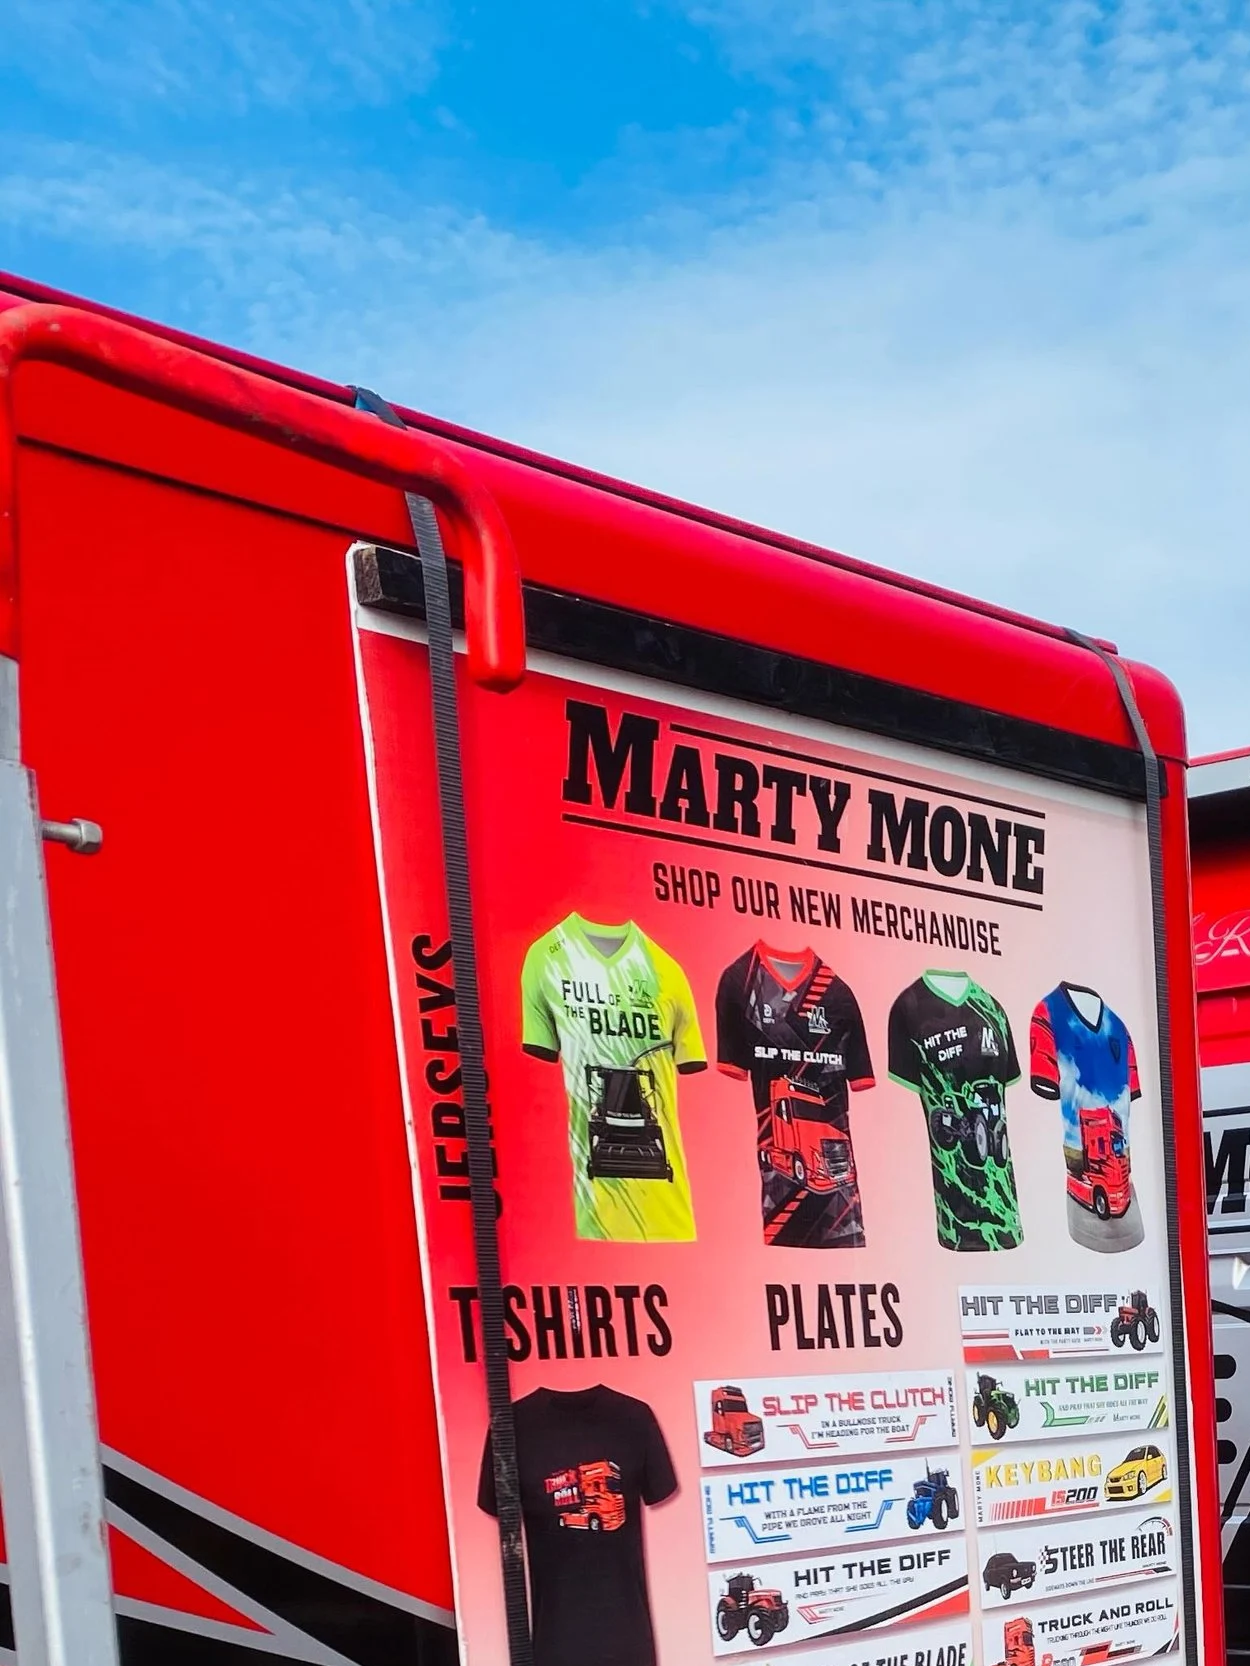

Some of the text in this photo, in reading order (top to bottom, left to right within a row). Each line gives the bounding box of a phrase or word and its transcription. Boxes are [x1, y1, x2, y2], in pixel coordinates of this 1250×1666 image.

[561, 699, 1045, 894] MARTY MONE
[653, 861, 1002, 956] SHOP OUR NEW MERCHANDISE
[562, 980, 620, 1005] FULL OF
[564, 1005, 661, 1040] THE BLADE
[923, 1026, 967, 1049] HIT THE
[754, 1046, 842, 1065] SLIP THE CLUTCH
[938, 1045, 963, 1061] DIFF
[411, 934, 503, 1219] JERSEYS
[766, 1283, 903, 1351] PLATES
[961, 1294, 1118, 1316] HIT THE DIFF
[1036, 1328, 1046, 1336] TO
[1024, 1371, 1159, 1397] HIT THE DIFF
[763, 1387, 946, 1416] SLIP THE CLUTCH
[821, 1420, 830, 1428] IN
[838, 1417, 876, 1427] BULLNOSE
[877, 1416, 901, 1424] TRUCK
[826, 1429, 859, 1438] HEADING
[860, 1427, 875, 1435] FOR
[876, 1426, 890, 1434] THE
[891, 1424, 910, 1433] BOAT
[985, 1454, 1102, 1488] KEYBANG
[728, 1469, 893, 1506] HIT THE DIFF
[1051, 1487, 1098, 1507] IS200
[761, 1511, 871, 1531] PIPE WE DROVE ALL NIGHT
[764, 1501, 868, 1520] WITH A FLAME FROM THE
[1043, 1531, 1166, 1574] STEER THE REAR
[794, 1549, 950, 1587] HIT THE DIFF
[1038, 1597, 1174, 1634] TRUCK AND ROLL
[1047, 1633, 1069, 1644] TRUCKING
[1069, 1630, 1089, 1640] THROUGH
